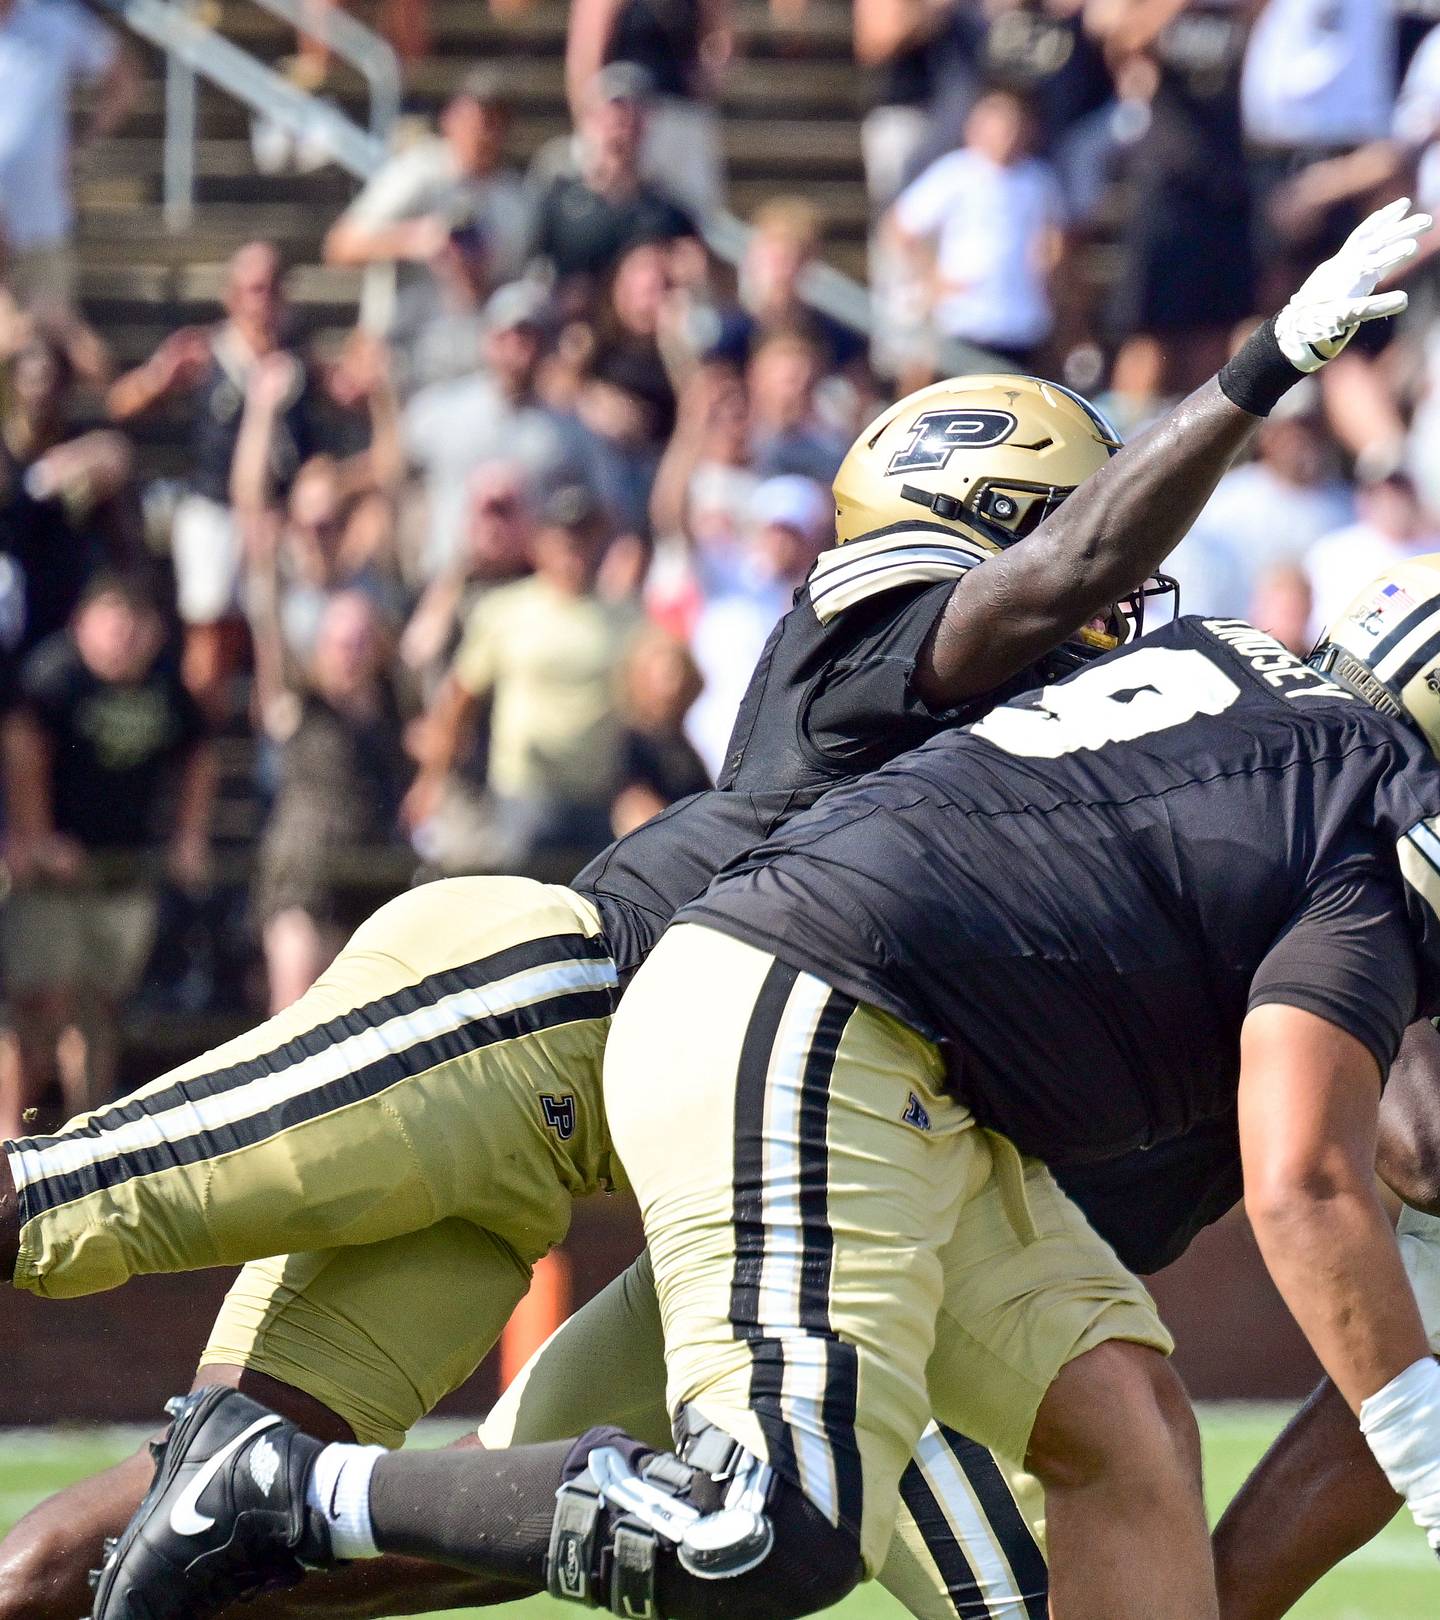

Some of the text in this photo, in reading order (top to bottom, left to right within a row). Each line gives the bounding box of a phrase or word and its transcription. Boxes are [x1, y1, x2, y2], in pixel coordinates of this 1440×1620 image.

[884, 409, 1018, 477] P
[1201, 620, 1355, 700] LINDSEY
[540, 1095, 576, 1140] P
